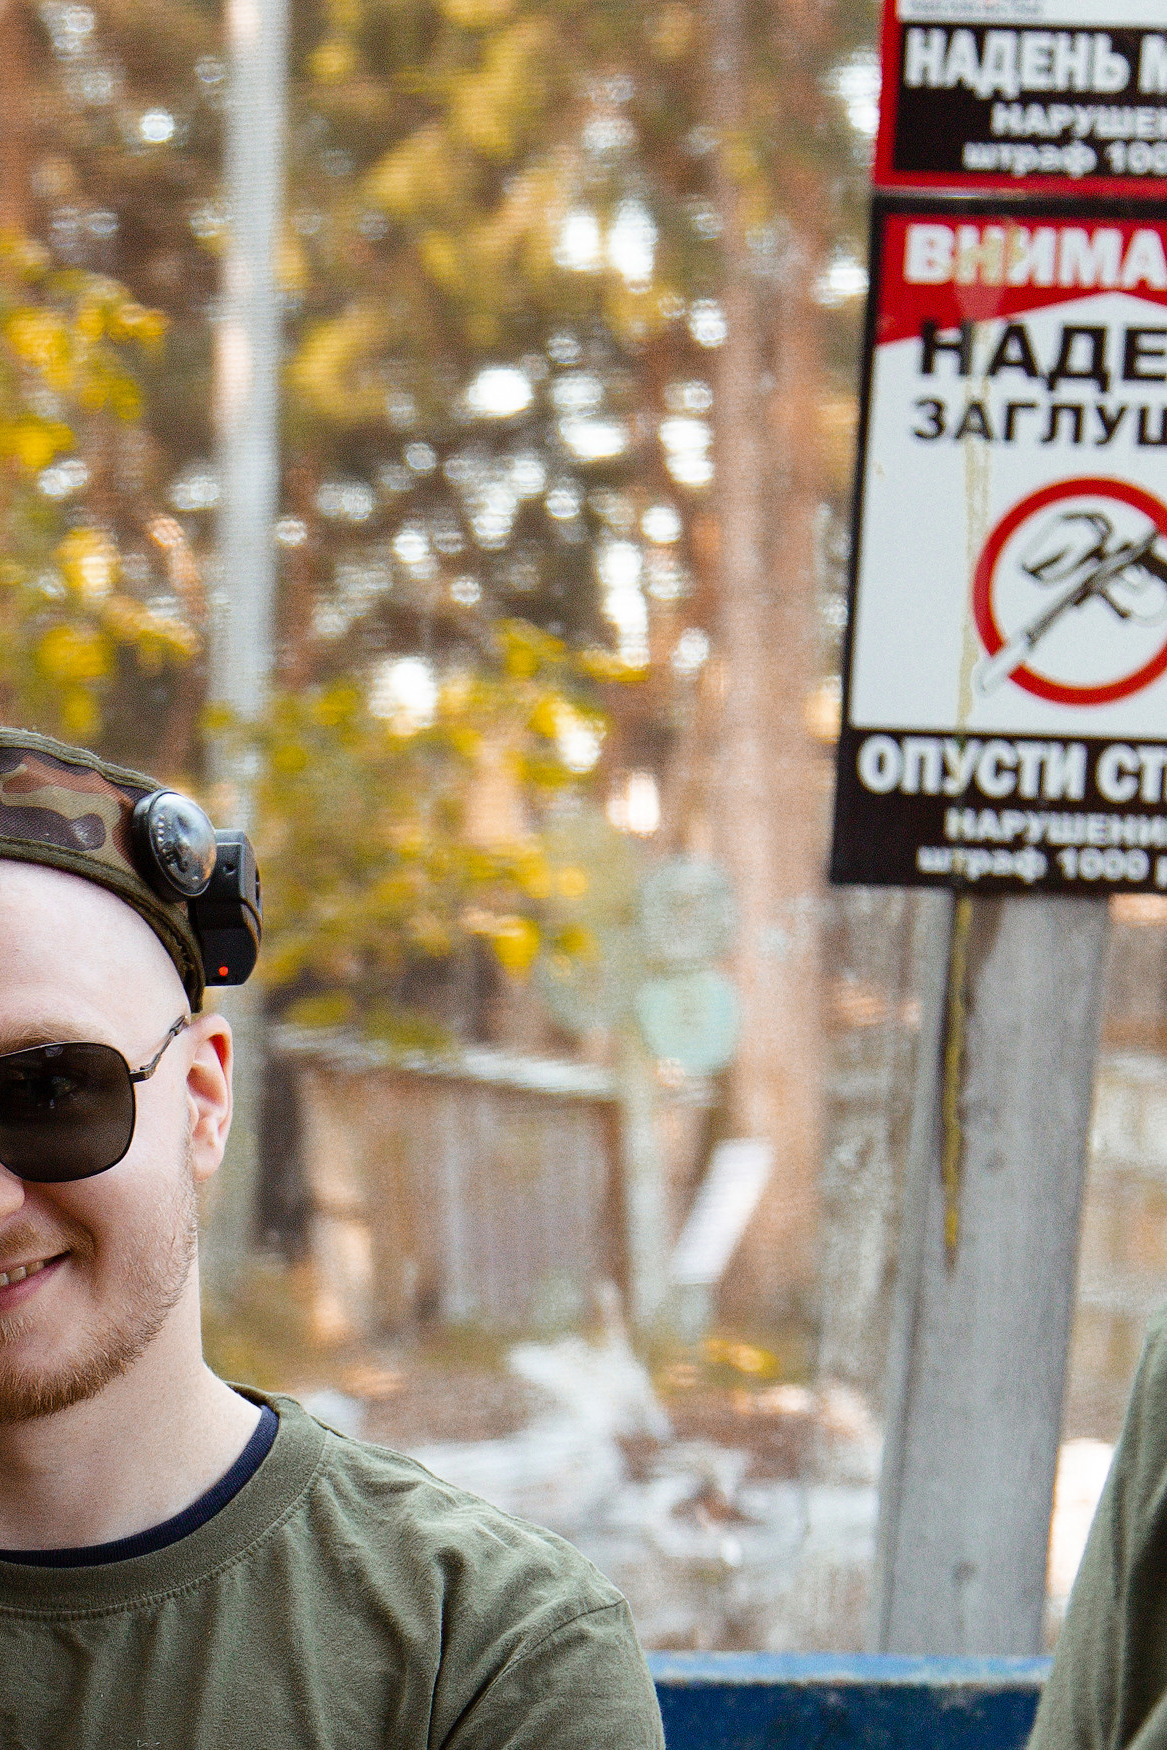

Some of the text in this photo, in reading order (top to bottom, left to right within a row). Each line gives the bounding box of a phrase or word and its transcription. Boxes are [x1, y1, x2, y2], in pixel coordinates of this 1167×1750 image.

[905, 27, 1131, 99] НАДЕНЬ
[962, 140, 1097, 178] штраф
[903, 223, 1167, 290] ВНИМА
[921, 320, 1167, 393] НАДЕ
[857, 734, 1088, 801] ОПУСТИ
[918, 845, 1047, 883] штраф
[1058, 848, 1149, 882] 1000
